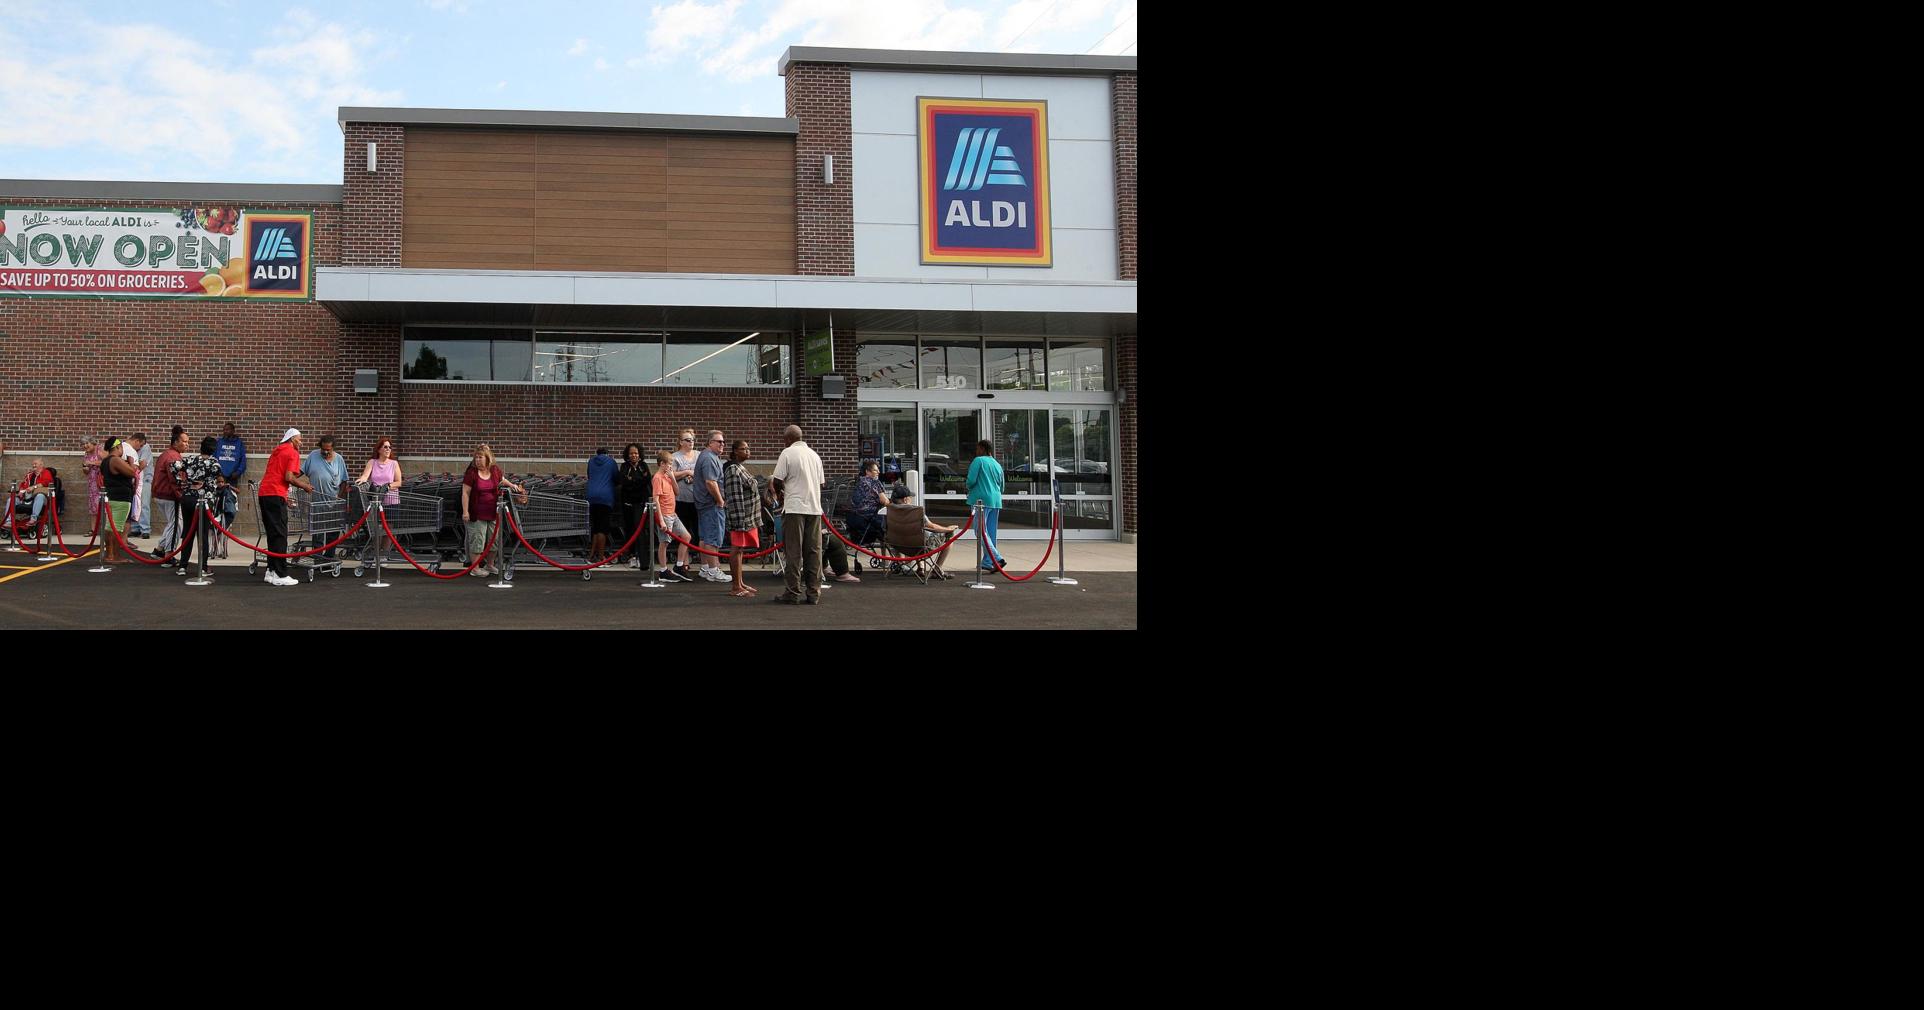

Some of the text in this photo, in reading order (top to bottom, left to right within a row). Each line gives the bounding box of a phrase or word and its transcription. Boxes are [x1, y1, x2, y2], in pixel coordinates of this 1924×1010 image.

[22, 212, 50, 226] hello
[59, 216, 153, 227] Your local ALDI is
[944, 199, 1027, 229] ALDI
[0, 232, 231, 269] NOW OPEN
[0, 272, 188, 289] SAVE UP TO 50% ON GROCERIES.
[253, 264, 297, 281] ALDI
